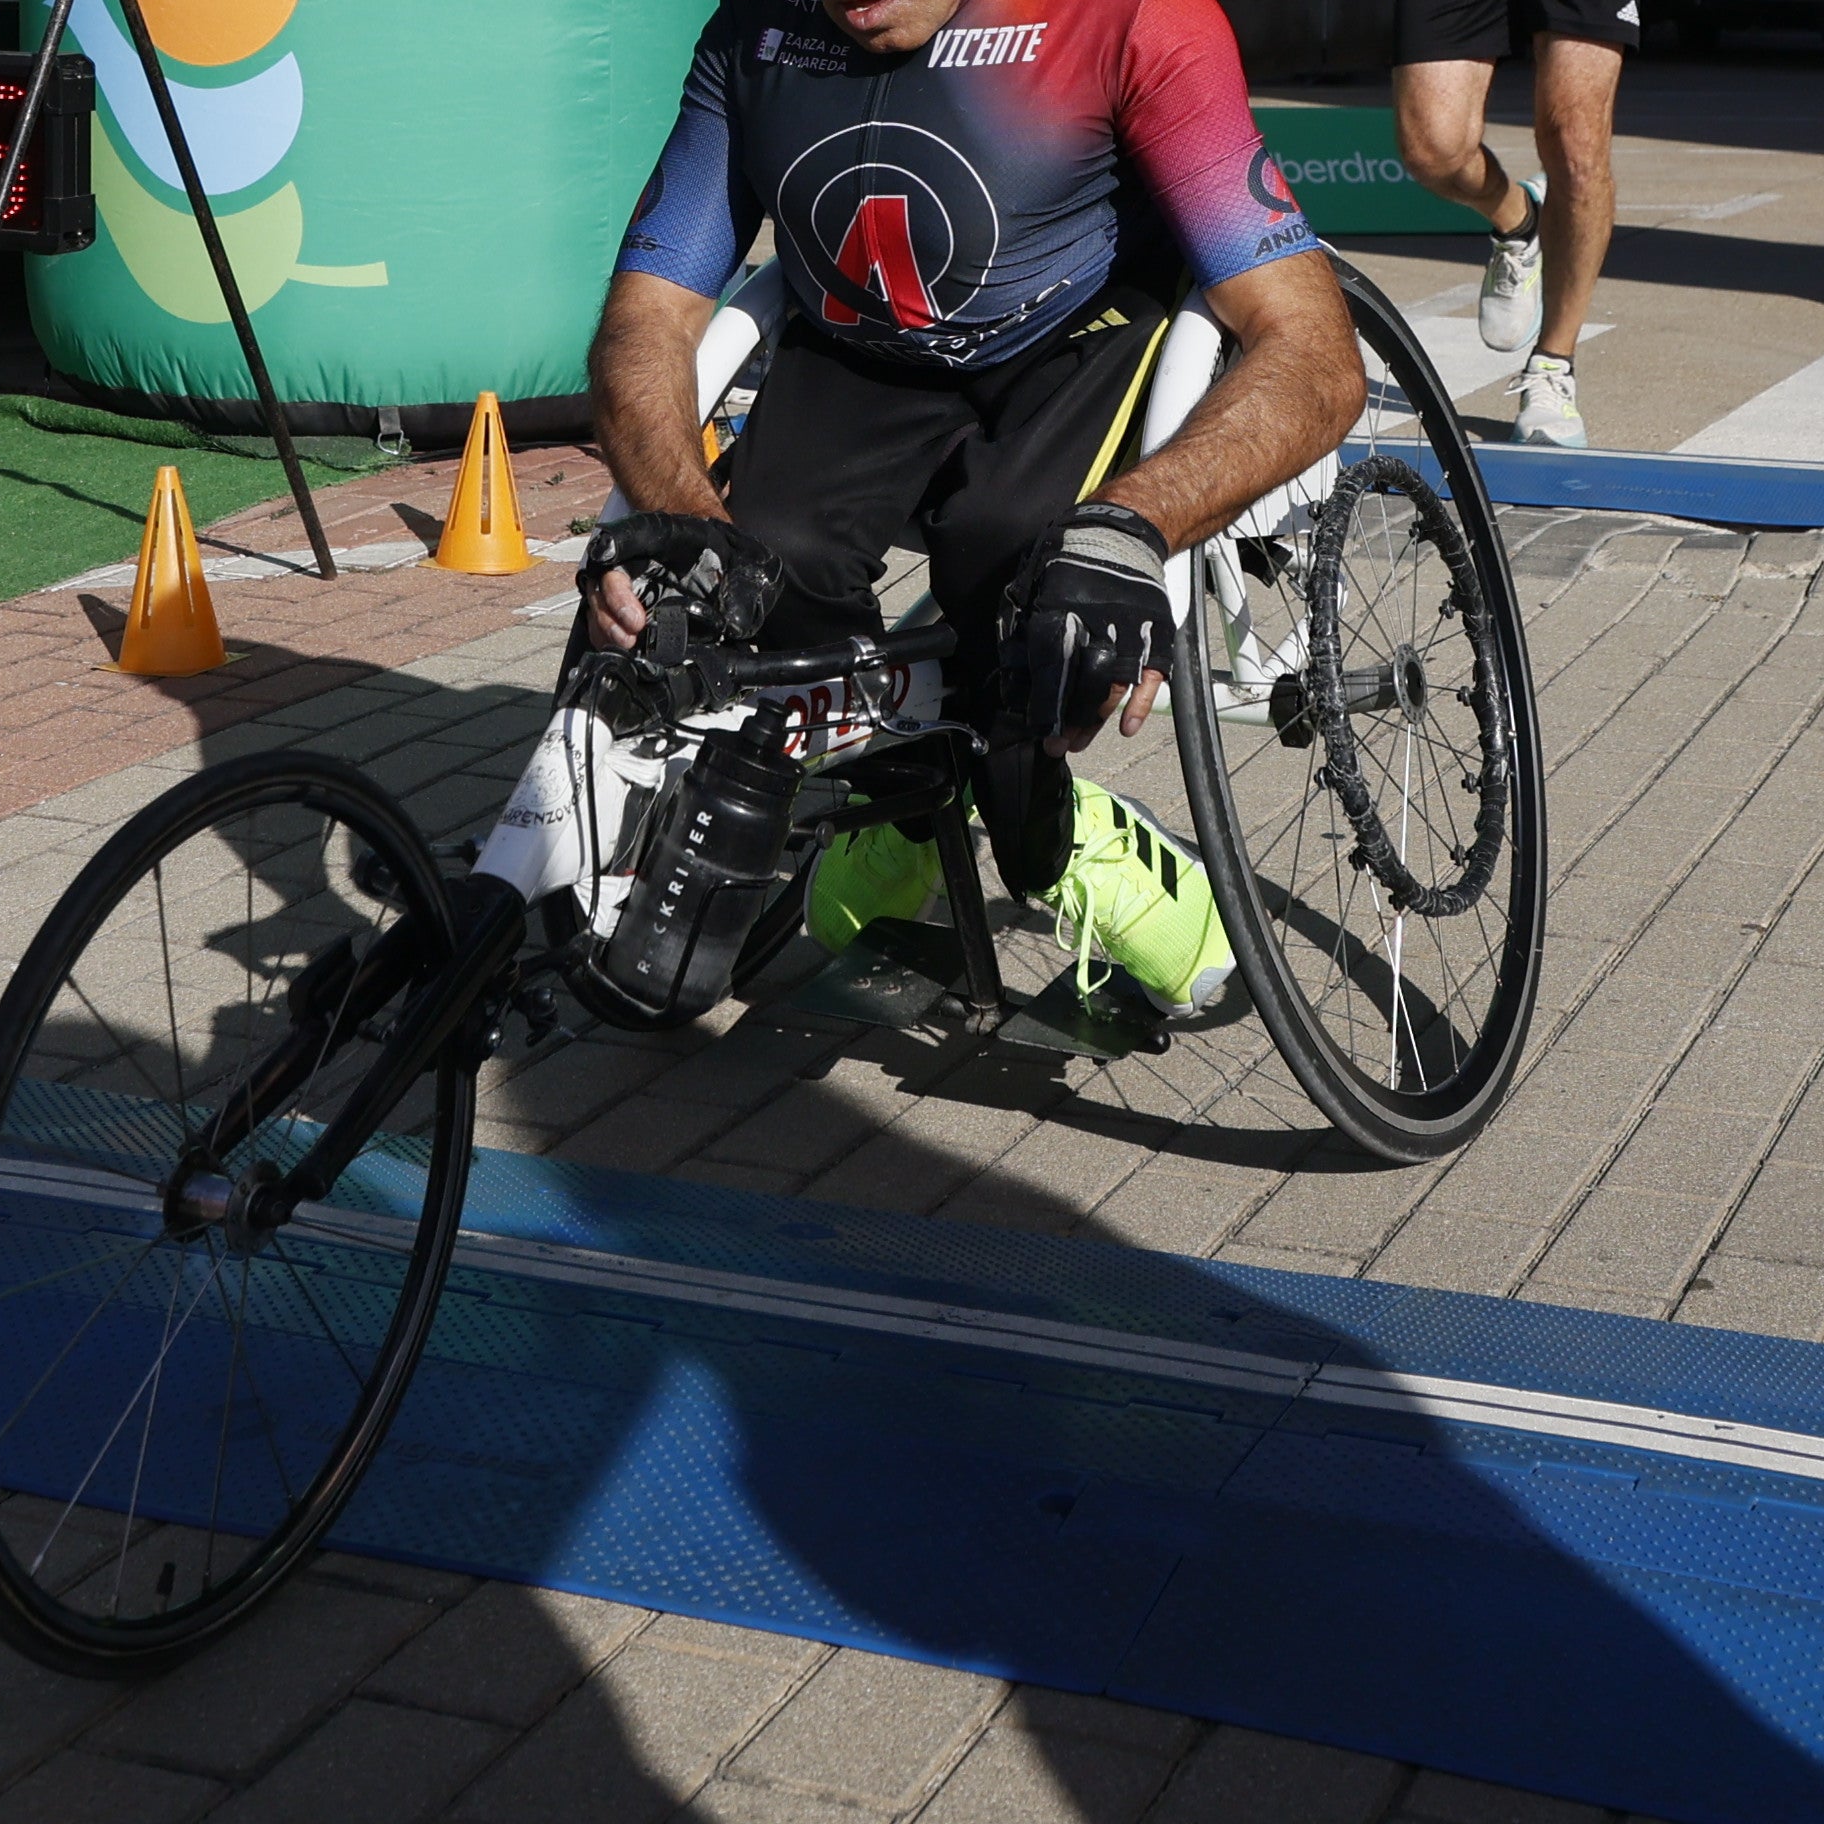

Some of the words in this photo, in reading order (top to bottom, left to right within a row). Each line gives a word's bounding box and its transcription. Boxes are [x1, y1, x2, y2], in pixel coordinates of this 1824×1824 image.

[784, 32, 826, 56] ZARZA
[829, 42, 851, 57] DE
[928, 22, 1049, 69] VICENTE
[636, 810, 714, 975] RCKRIDER
